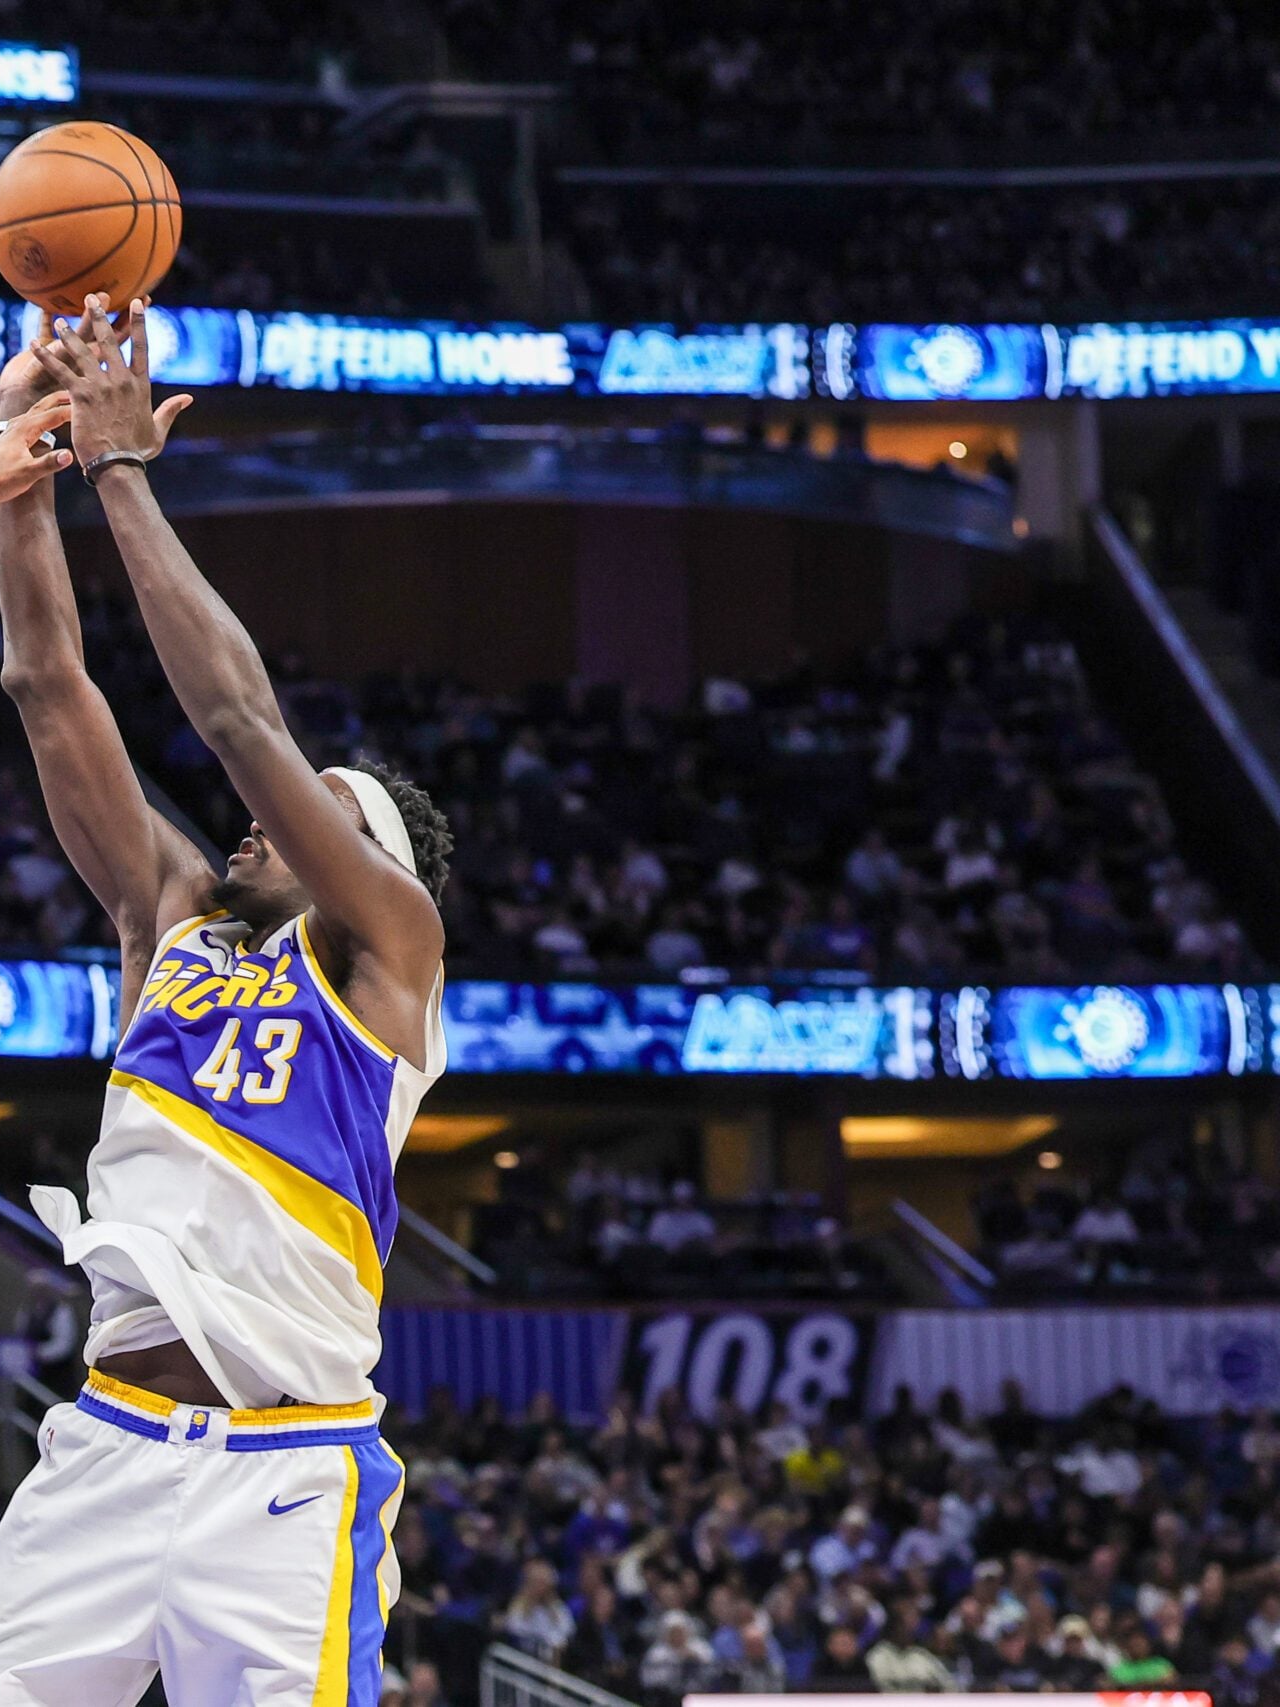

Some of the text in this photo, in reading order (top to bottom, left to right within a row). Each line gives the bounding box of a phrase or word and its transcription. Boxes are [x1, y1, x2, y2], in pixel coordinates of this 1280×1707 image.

[437, 331, 574, 385] HOME
[1067, 330, 1246, 388] DEFEND
[143, 953, 298, 1021] PACRS
[193, 1017, 303, 1104] 43
[639, 1312, 859, 1425] 108
